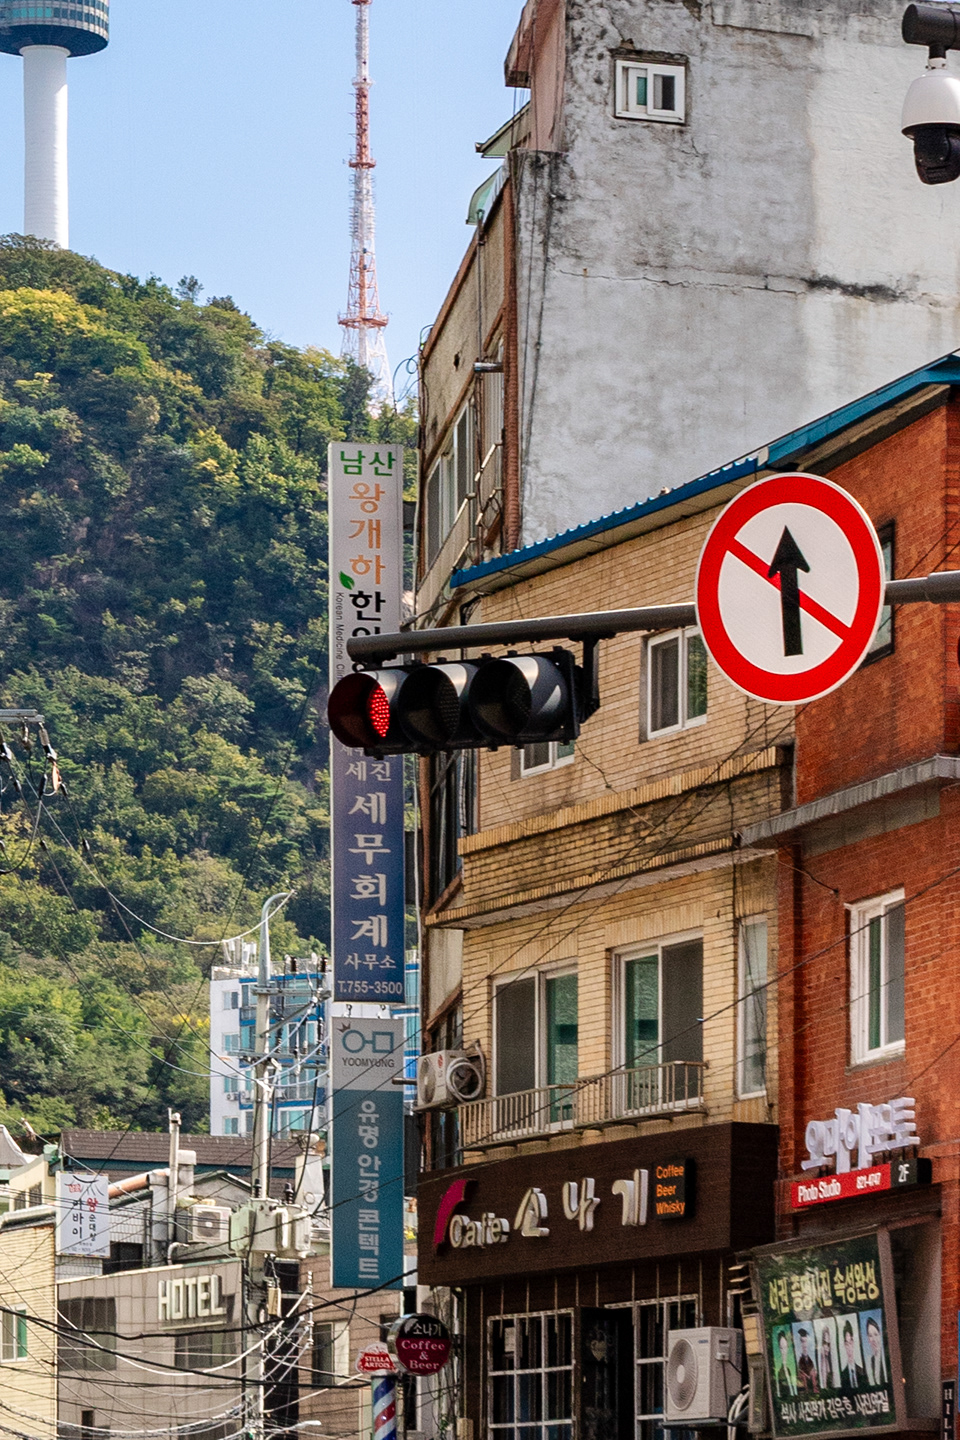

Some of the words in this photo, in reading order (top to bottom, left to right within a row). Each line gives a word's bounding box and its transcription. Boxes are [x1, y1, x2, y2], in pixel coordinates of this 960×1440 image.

[340, 450, 396, 477] 남산
[335, 592, 344, 620] Korean
[335, 624, 344, 660] Medicine
[345, 761, 392, 782] 세진
[348, 792, 391, 948] 세무회계
[344, 953, 397, 970] 사무소
[338, 980, 403, 995] T.755-3500
[342, 1057, 395, 1068] YOOMYUNG
[358, 1100, 380, 1149] 유명
[801, 1097, 920, 1175] 오마이포토
[357, 1154, 382, 1203] 안경
[656, 1164, 685, 1179] Coffee
[898, 1163, 910, 1183] 2F
[656, 1184, 677, 1198] Beer
[798, 1184, 818, 1203] Photo
[819, 1179, 841, 1199] Studio
[449, 1212, 510, 1249] Cafe
[514, 1168, 649, 1238] 소나기
[656, 1200, 686, 1215] Whisky
[158, 1274, 227, 1321] HOTEL
[413, 1323, 442, 1337] 소나기
[401, 1340, 445, 1350] Coffee
[409, 1359, 439, 1370] Beer
[419, 1351, 429, 1361] &
